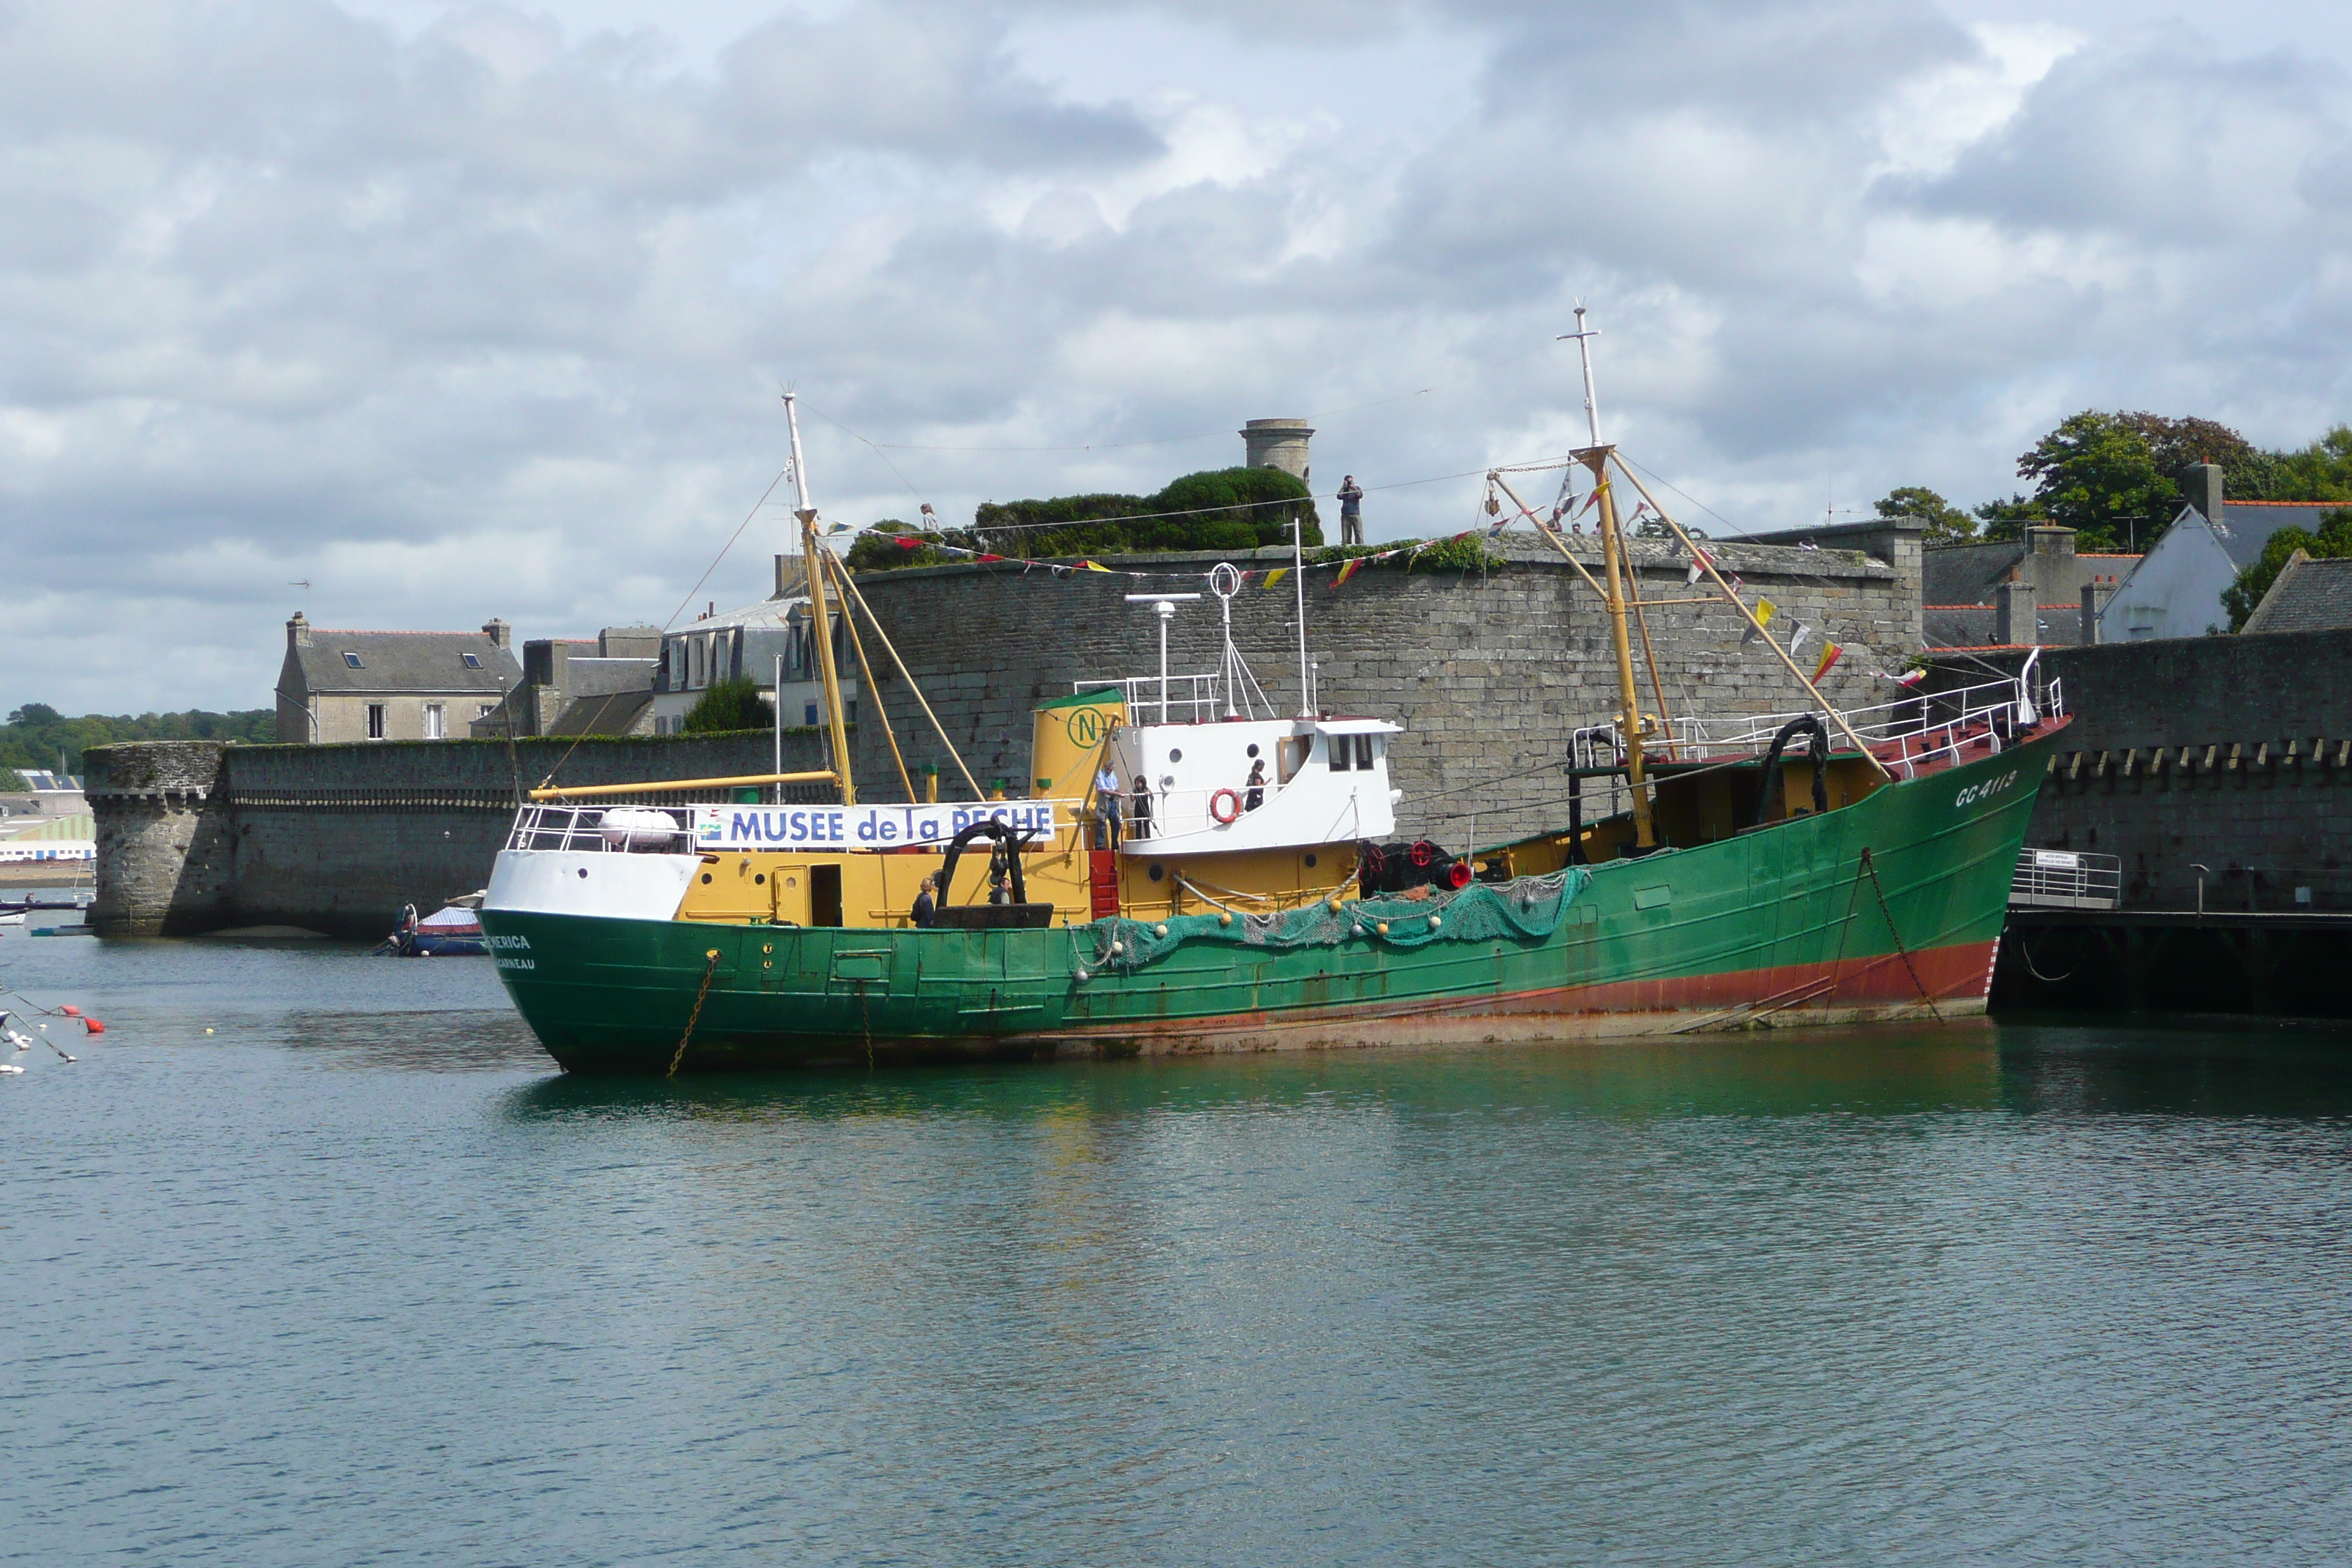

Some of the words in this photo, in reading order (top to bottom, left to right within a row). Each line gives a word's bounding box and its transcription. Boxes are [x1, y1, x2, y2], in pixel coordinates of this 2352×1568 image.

[731, 811, 843, 842] MUSEE
[857, 810, 897, 840] de
[905, 808, 939, 840] la
